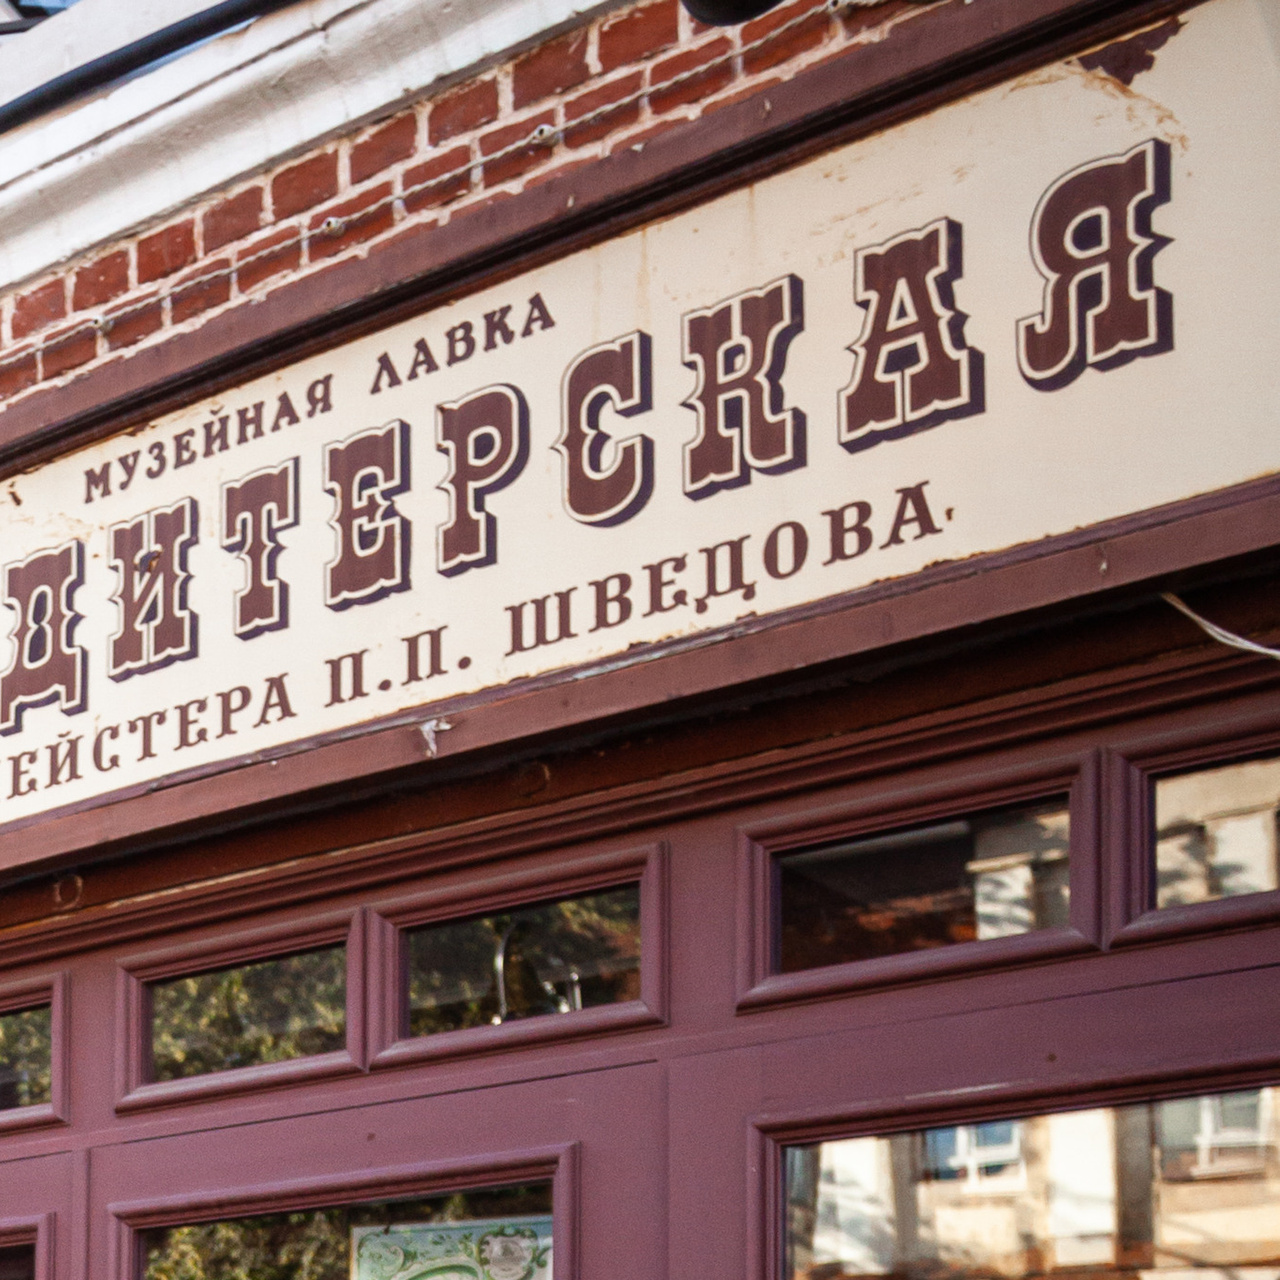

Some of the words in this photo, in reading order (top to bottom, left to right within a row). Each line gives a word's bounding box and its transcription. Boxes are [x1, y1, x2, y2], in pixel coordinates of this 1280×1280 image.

[84, 373, 334, 504] МУЗЕЙНАЯ
[369, 291, 556, 394] ЛАВКА
[503, 479, 944, 657] ШВЕДОВА
